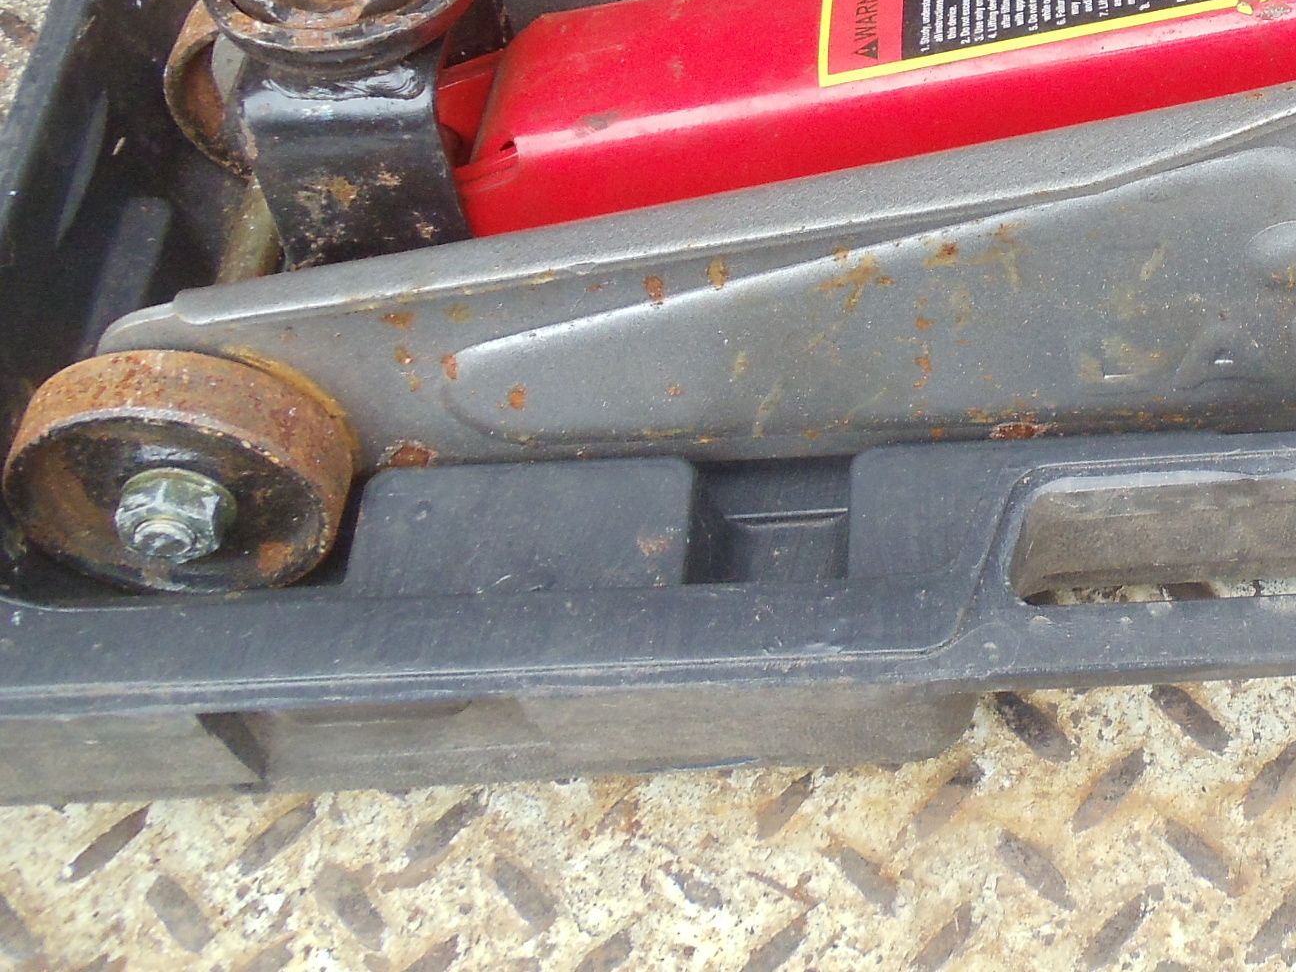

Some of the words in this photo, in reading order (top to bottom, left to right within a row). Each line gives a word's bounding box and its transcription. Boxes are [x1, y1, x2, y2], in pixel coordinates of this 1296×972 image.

[1029, 2, 1037, 13] not
[1042, 4, 1051, 21] while
[1071, 0, 1081, 14] may
[934, 0, 943, 33] instructions
[974, 6, 985, 20] only
[1015, 11, 1024, 25] with
[1028, 13, 1037, 23] Do
[961, 15, 970, 26] not
[988, 10, 999, 31] Lifting
[1001, 13, 1010, 28] after
[1057, 17, 1065, 25] 6.
[961, 26, 970, 36] Do
[974, 20, 983, 33] Use
[1029, 23, 1037, 31] 5.
[934, 33, 943, 42] all
[948, 26, 956, 39] this
[974, 33, 984, 41] 3.
[988, 31, 997, 39] 4.
[960, 36, 970, 44] 2.
